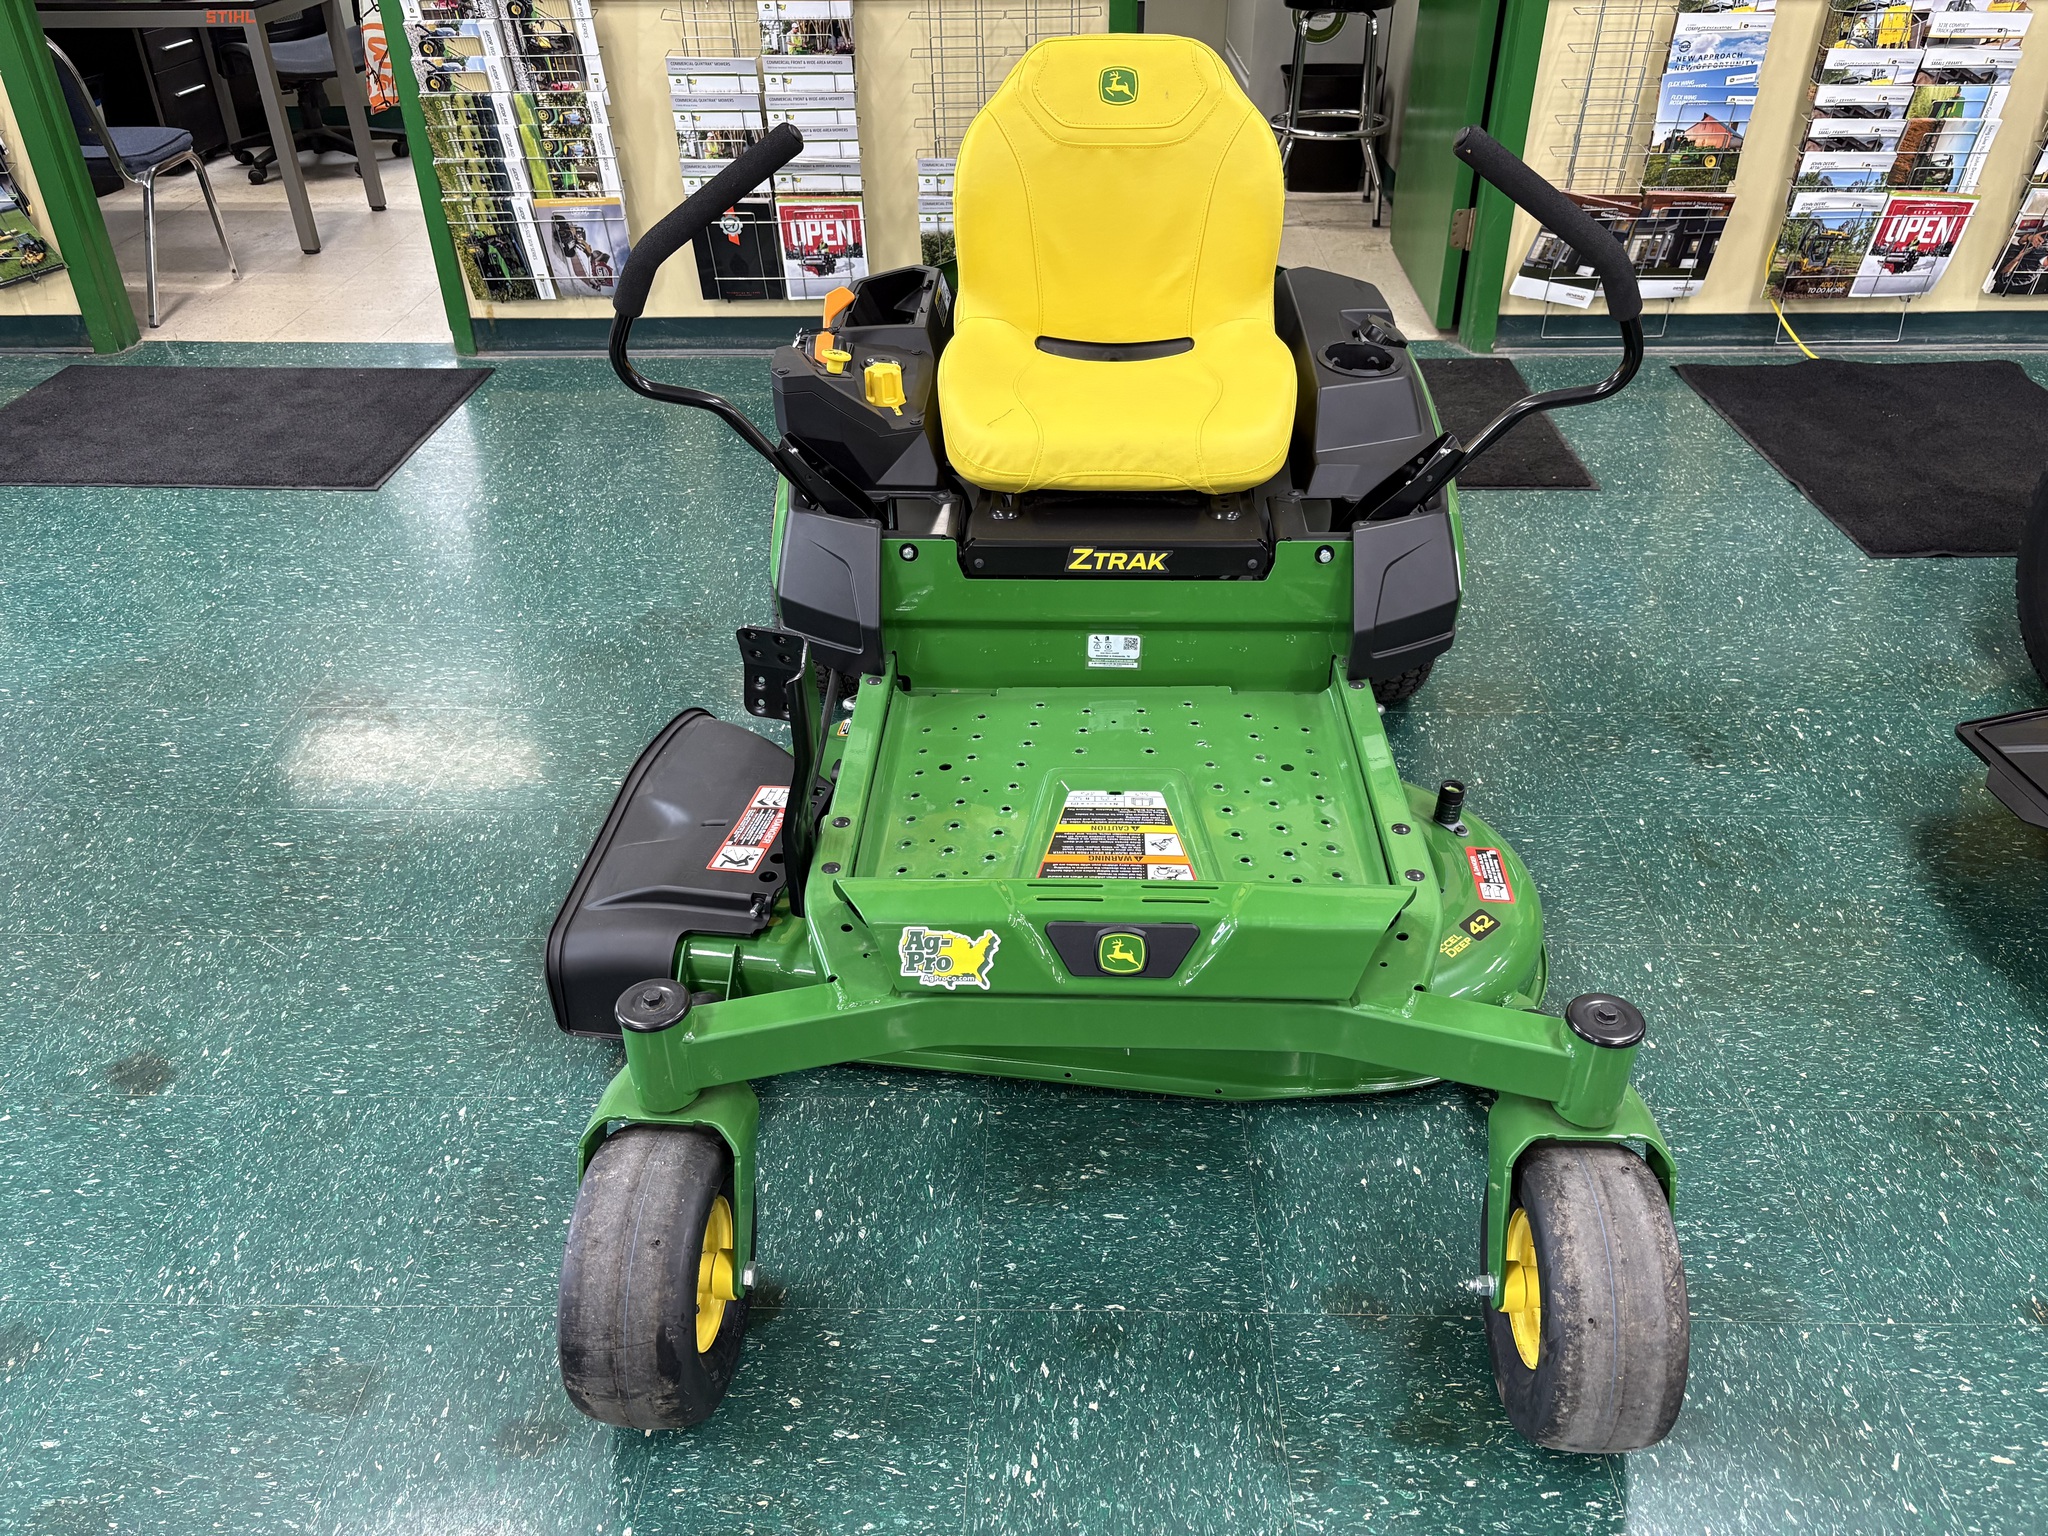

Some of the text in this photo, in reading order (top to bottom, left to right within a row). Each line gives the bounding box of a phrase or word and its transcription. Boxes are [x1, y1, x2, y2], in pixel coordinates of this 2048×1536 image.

[206, 10, 255, 24] STIHL
[1697, 52, 1744, 61] APPROACH
[790, 219, 854, 247] OPEN
[1884, 216, 1957, 244] OPEN
[1068, 548, 1168, 571] ZTRAK
[1469, 914, 1494, 935] 42
[904, 930, 952, 954] Ag-
[1445, 937, 1472, 958] DEEP
[905, 952, 952, 974] Pro
[922, 974, 976, 984] AgProCo.com
